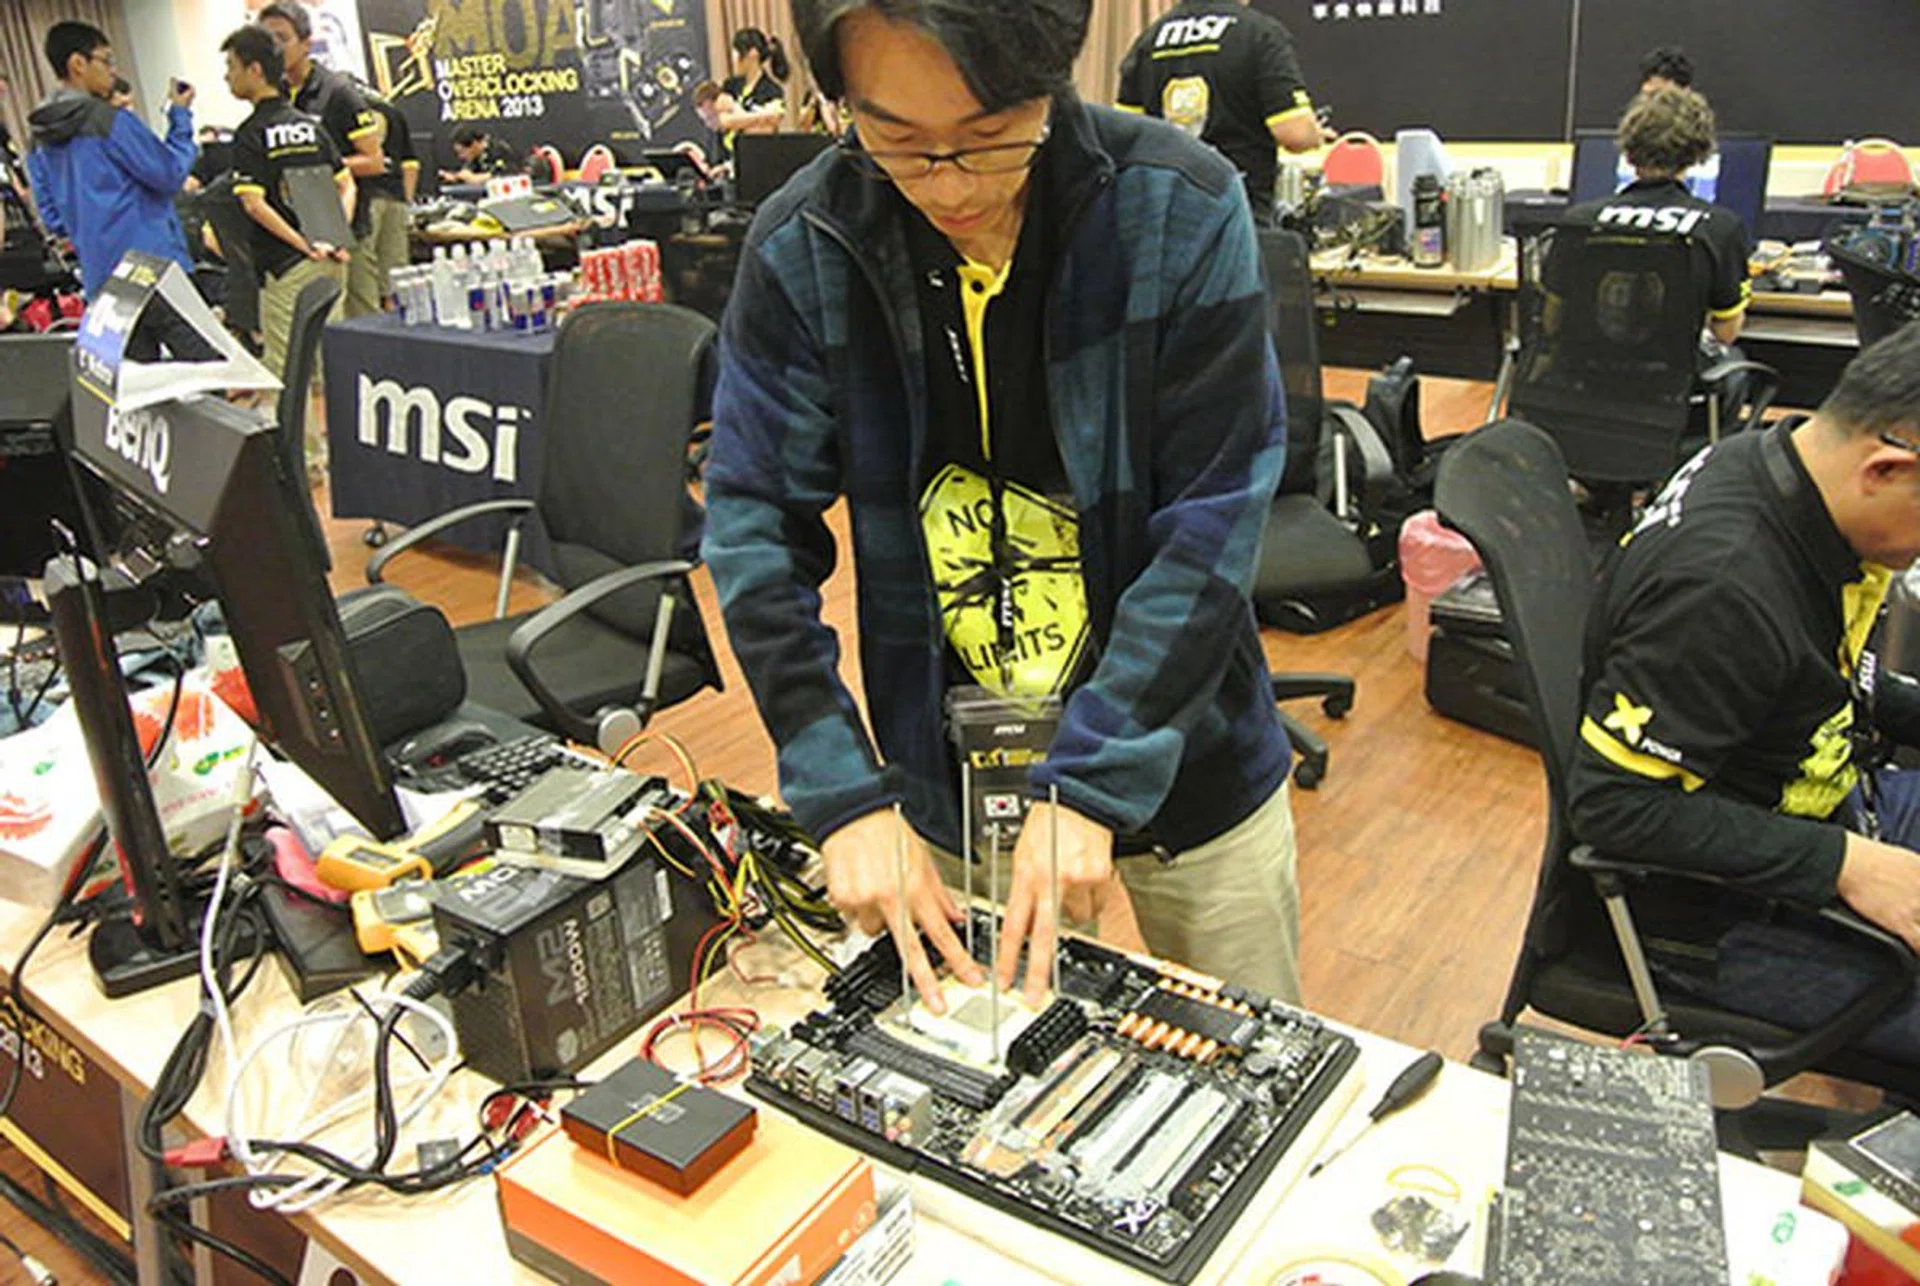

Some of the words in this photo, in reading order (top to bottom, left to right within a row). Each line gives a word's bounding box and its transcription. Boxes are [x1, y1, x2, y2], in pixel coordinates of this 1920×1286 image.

[1154, 15, 1232, 47] msi
[435, 54, 506, 79] MASTER
[438, 67, 578, 101] OVERCLOCKING
[441, 97, 500, 122] ARENA
[500, 94, 545, 118] 2013
[265, 121, 316, 149] msi
[1597, 205, 1702, 235] msi
[358, 372, 519, 483] msi
[105, 406, 170, 494] BenQ
[946, 498, 994, 537] NO
